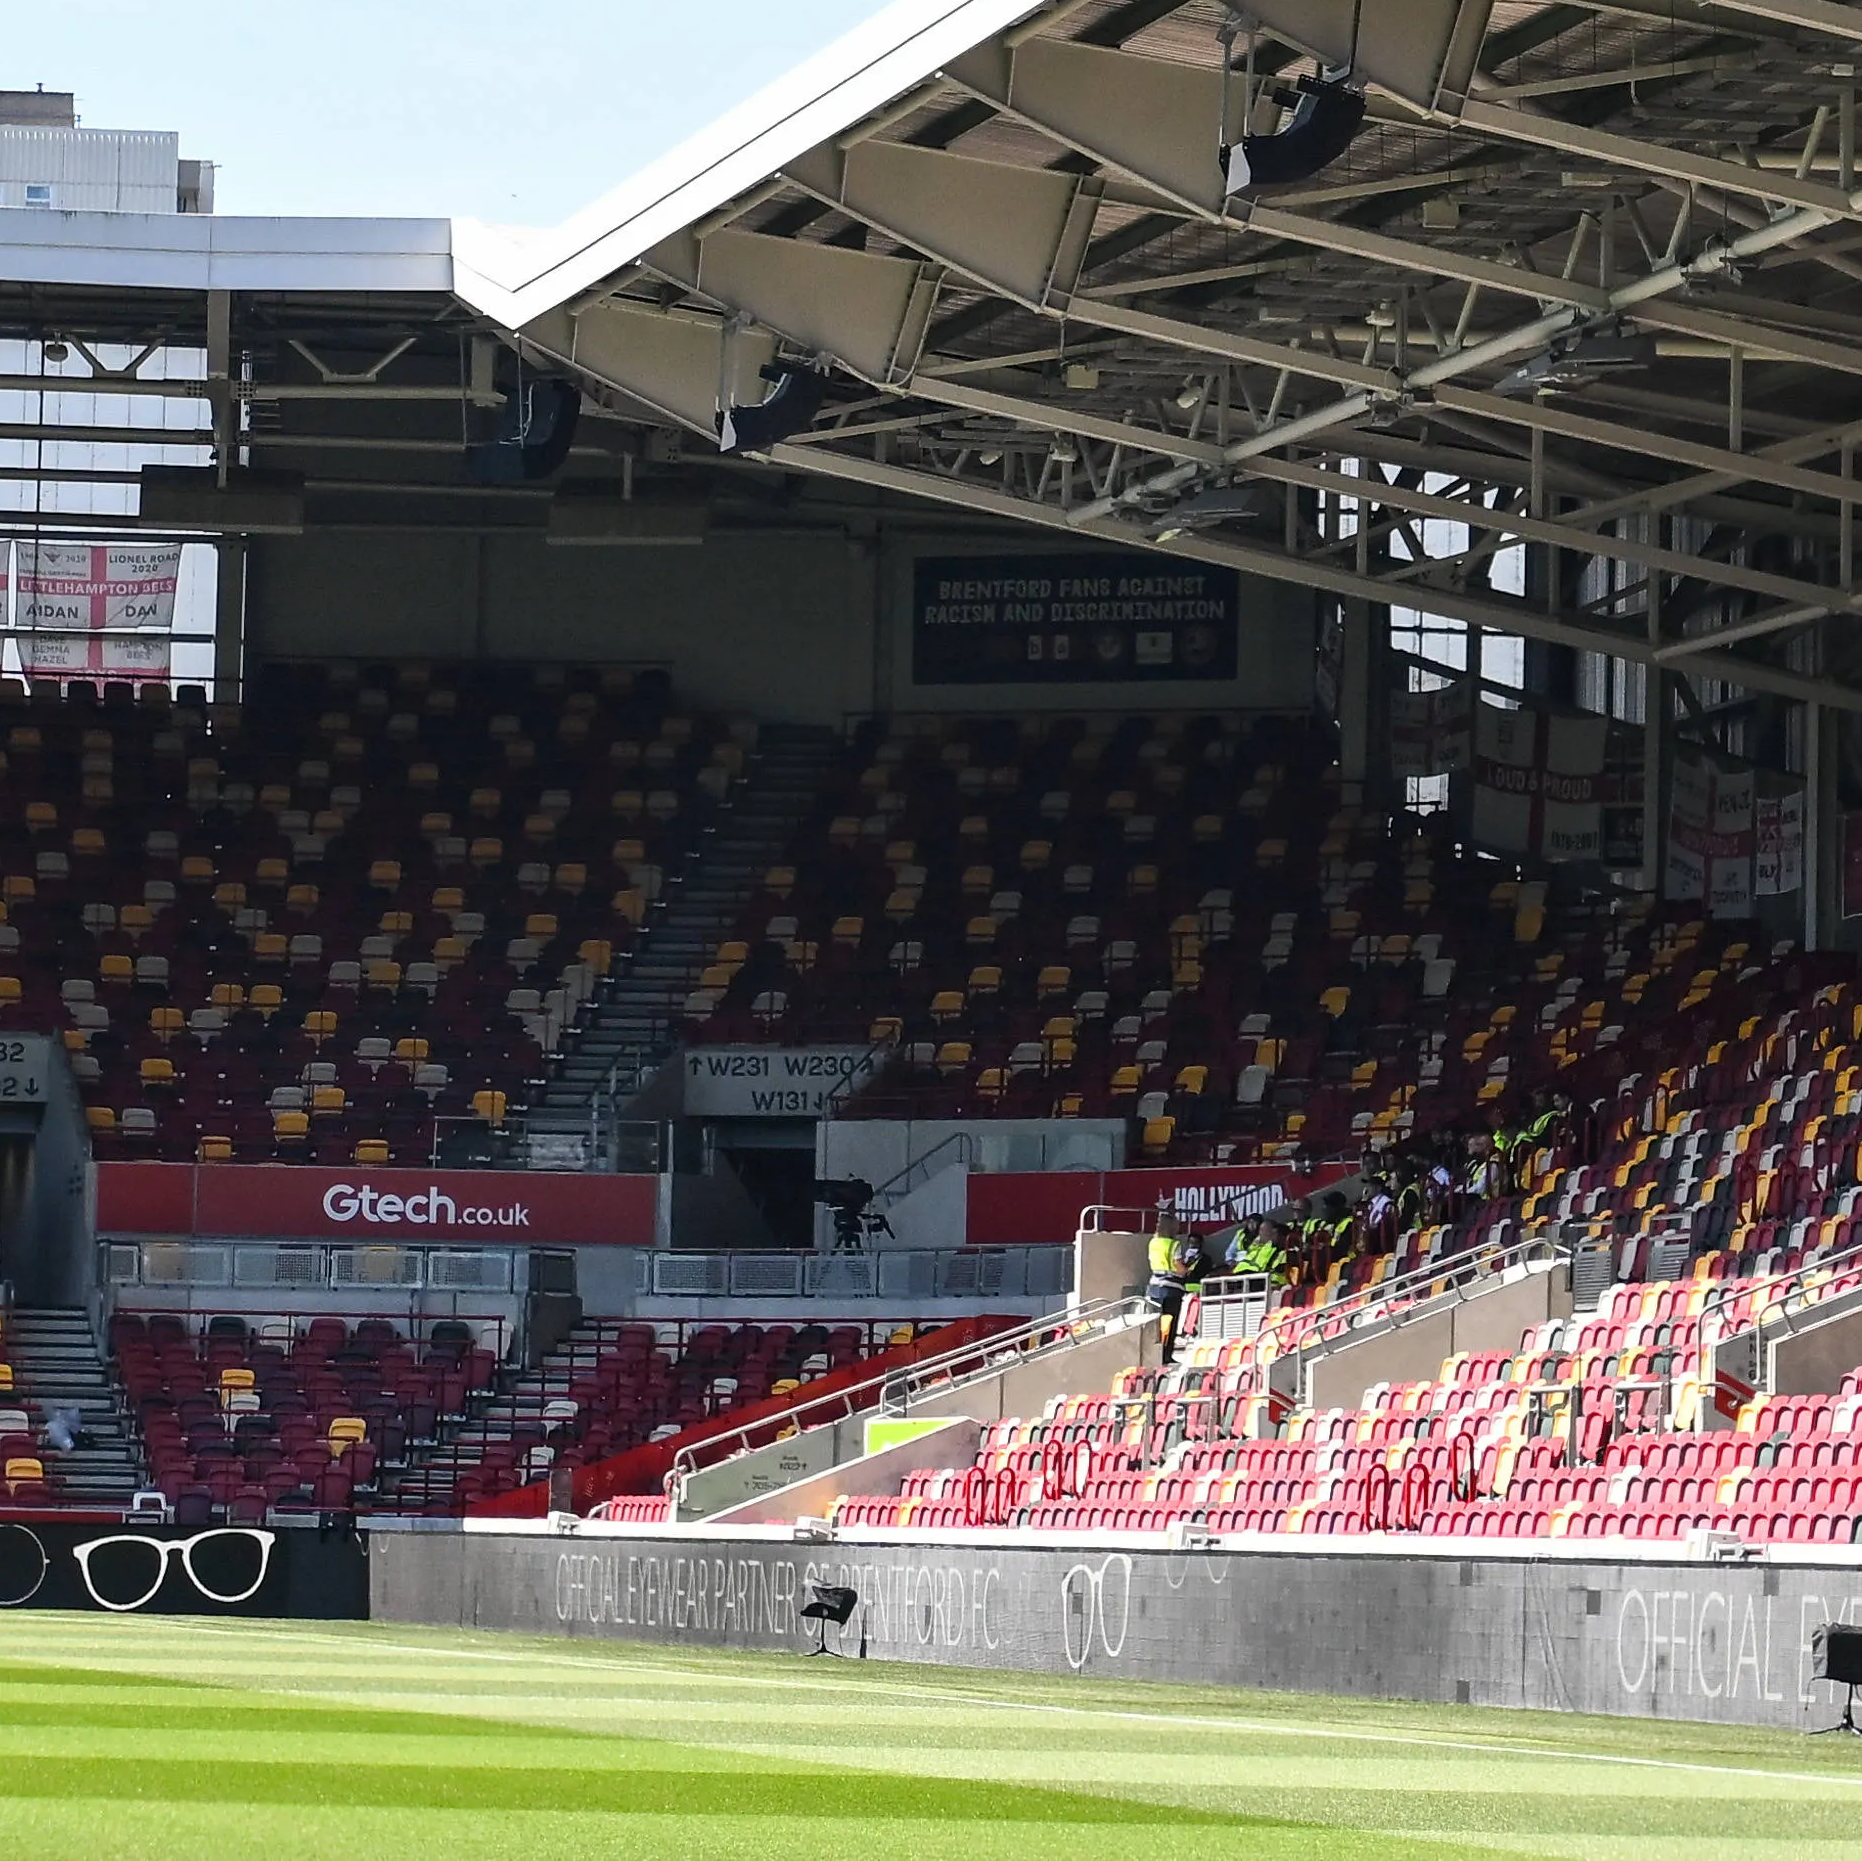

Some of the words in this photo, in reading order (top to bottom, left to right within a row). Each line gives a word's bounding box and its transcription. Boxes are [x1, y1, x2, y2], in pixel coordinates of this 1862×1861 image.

[109, 555, 146, 564] LIONEL
[150, 553, 179, 563] ROAD
[19, 580, 138, 595] LITLEHAMPTON
[938, 579, 1051, 600] BRENTFORD
[1059, 579, 1111, 597] FANS
[1116, 575, 1205, 597] AGAINST
[26, 604, 79, 619] AIDAN
[125, 603, 157, 618] DAN
[924, 604, 996, 624] RACISM
[1003, 603, 1044, 622] AND
[1051, 600, 1225, 622] DISCRIMINATION
[1542, 775, 1592, 800] PROUD
[707, 1056, 769, 1076] W231
[784, 1056, 855, 1076] W230
[751, 1090, 808, 1111] W131
[322, 1184, 530, 1228] Gtech.co.uk
[555, 1553, 624, 1624] OFFICIAL
[627, 1555, 709, 1629] EYEWEAR
[714, 1558, 798, 1635] PARTNER
[973, 1568, 1000, 1649] FC
[1617, 1587, 1783, 1704] OFFICIAL
